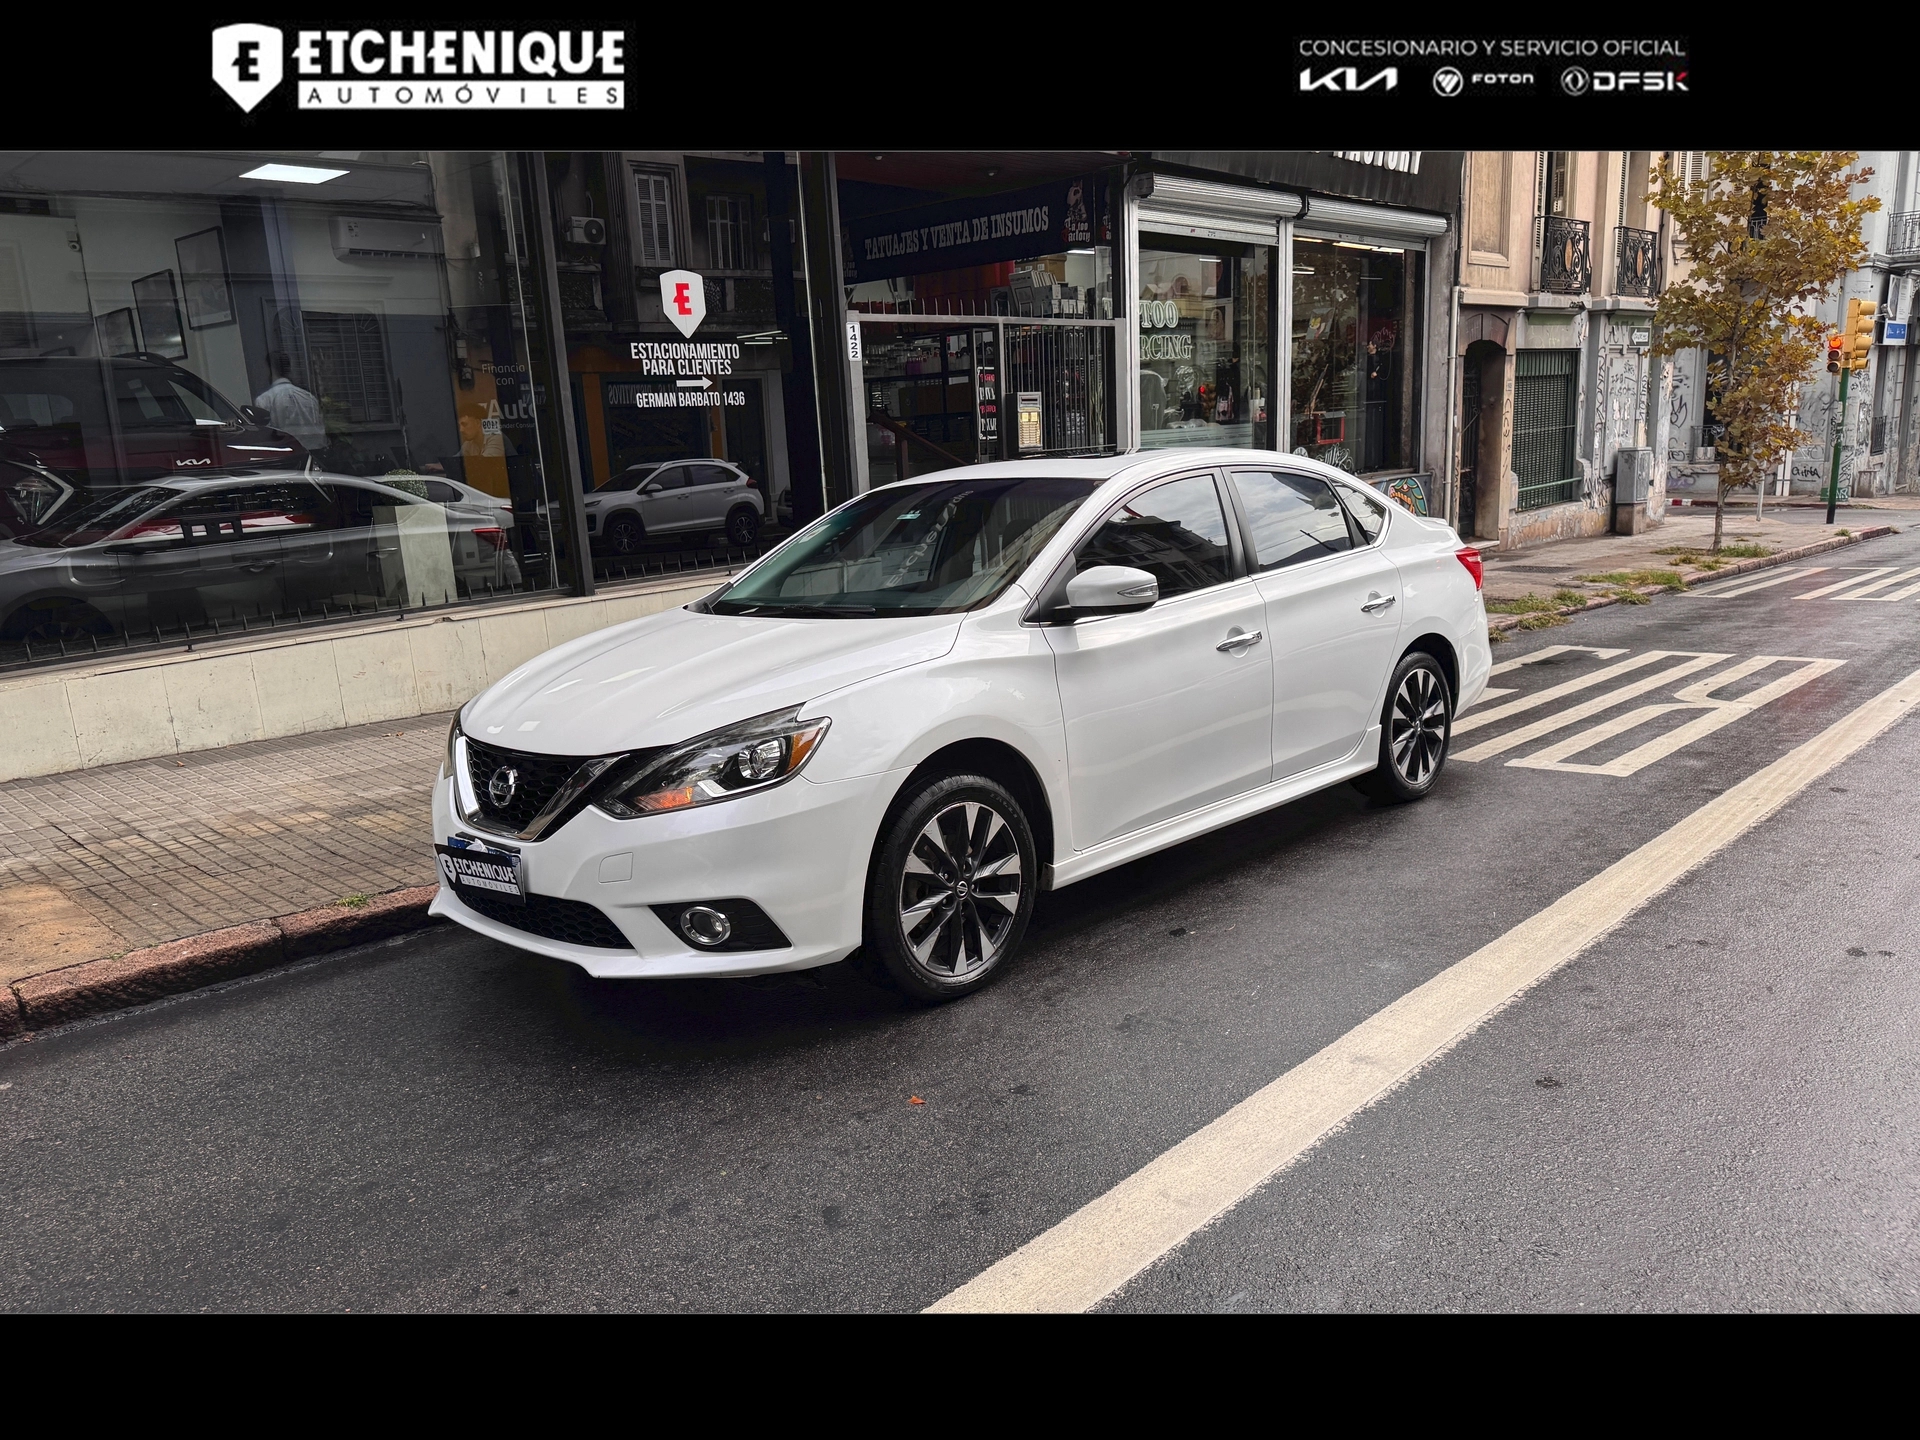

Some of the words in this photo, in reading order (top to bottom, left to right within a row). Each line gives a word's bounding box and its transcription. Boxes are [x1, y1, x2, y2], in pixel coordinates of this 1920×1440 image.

[865, 229, 920, 261] TATUAJES
[921, 228, 930, 251] Y
[931, 219, 971, 249] VENTA
[972, 216, 989, 242] DE
[991, 206, 1049, 239] INSUMOS
[850, 325, 859, 359] 1422
[630, 342, 740, 360] ESTACIONAMIENTO
[481, 363, 525, 374] Financia
[642, 359, 676, 376] PARA
[678, 359, 732, 376] CLIENTES
[496, 377, 514, 386] con
[636, 392, 677, 408] GERMAN
[679, 391, 721, 407] BARBATO
[723, 391, 746, 406] 1436
[452, 857, 517, 884] ETCHENIQUE
